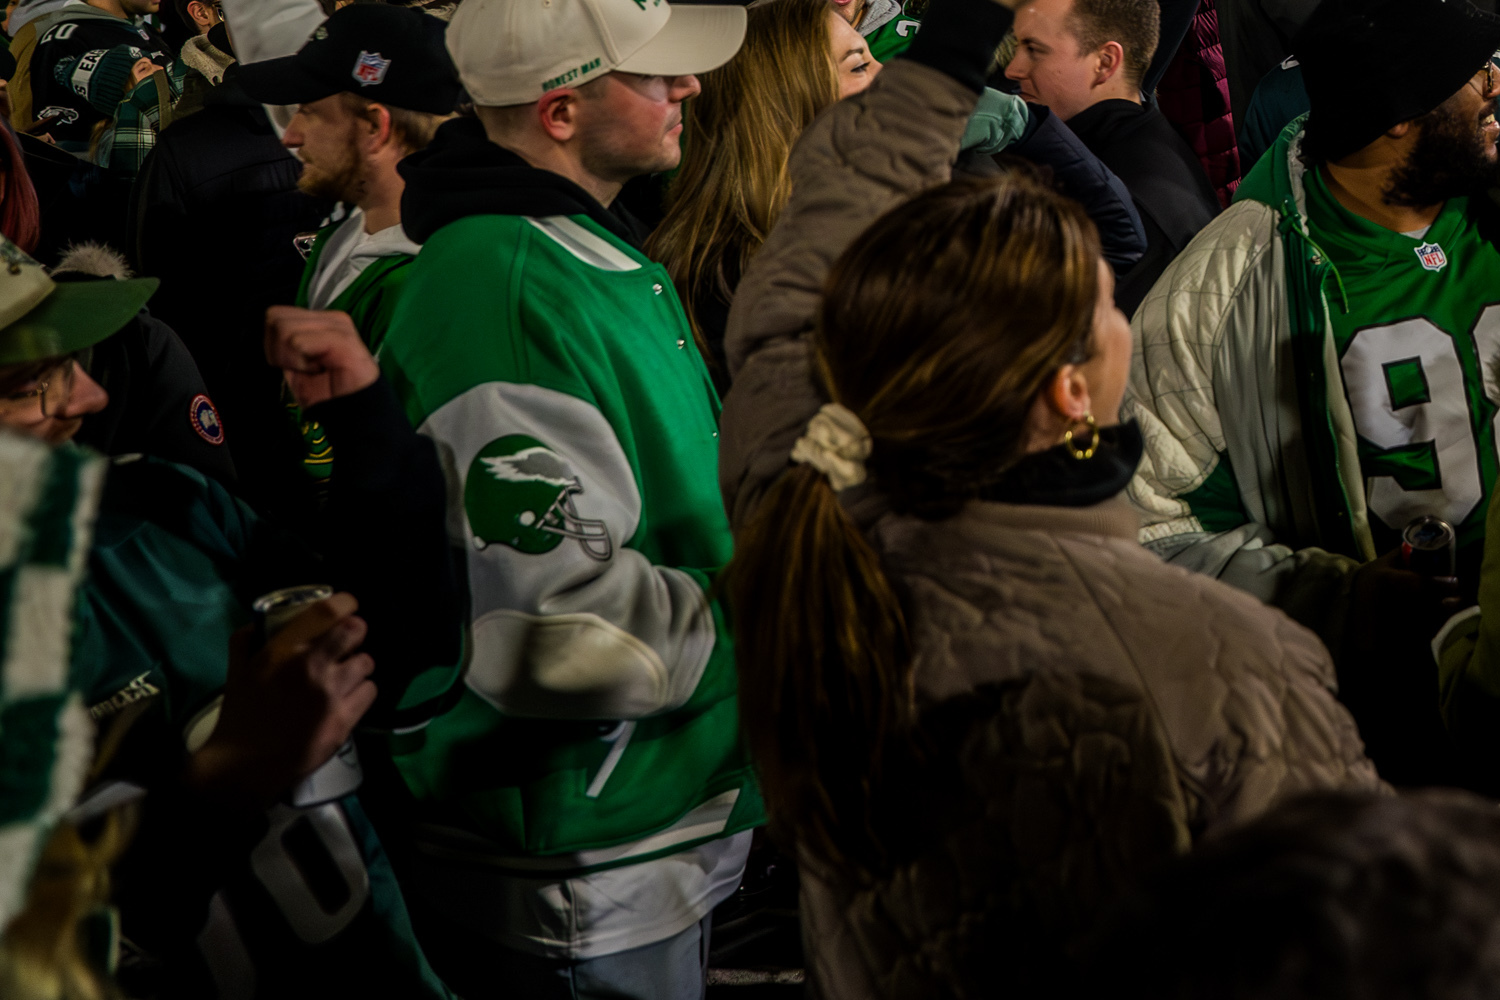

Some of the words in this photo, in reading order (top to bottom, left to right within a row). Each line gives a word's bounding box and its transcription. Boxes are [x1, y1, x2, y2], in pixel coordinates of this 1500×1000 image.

[542, 68, 579, 92] HONEST
[581, 58, 601, 75] MAN
[1423, 251, 1444, 266] NFL
